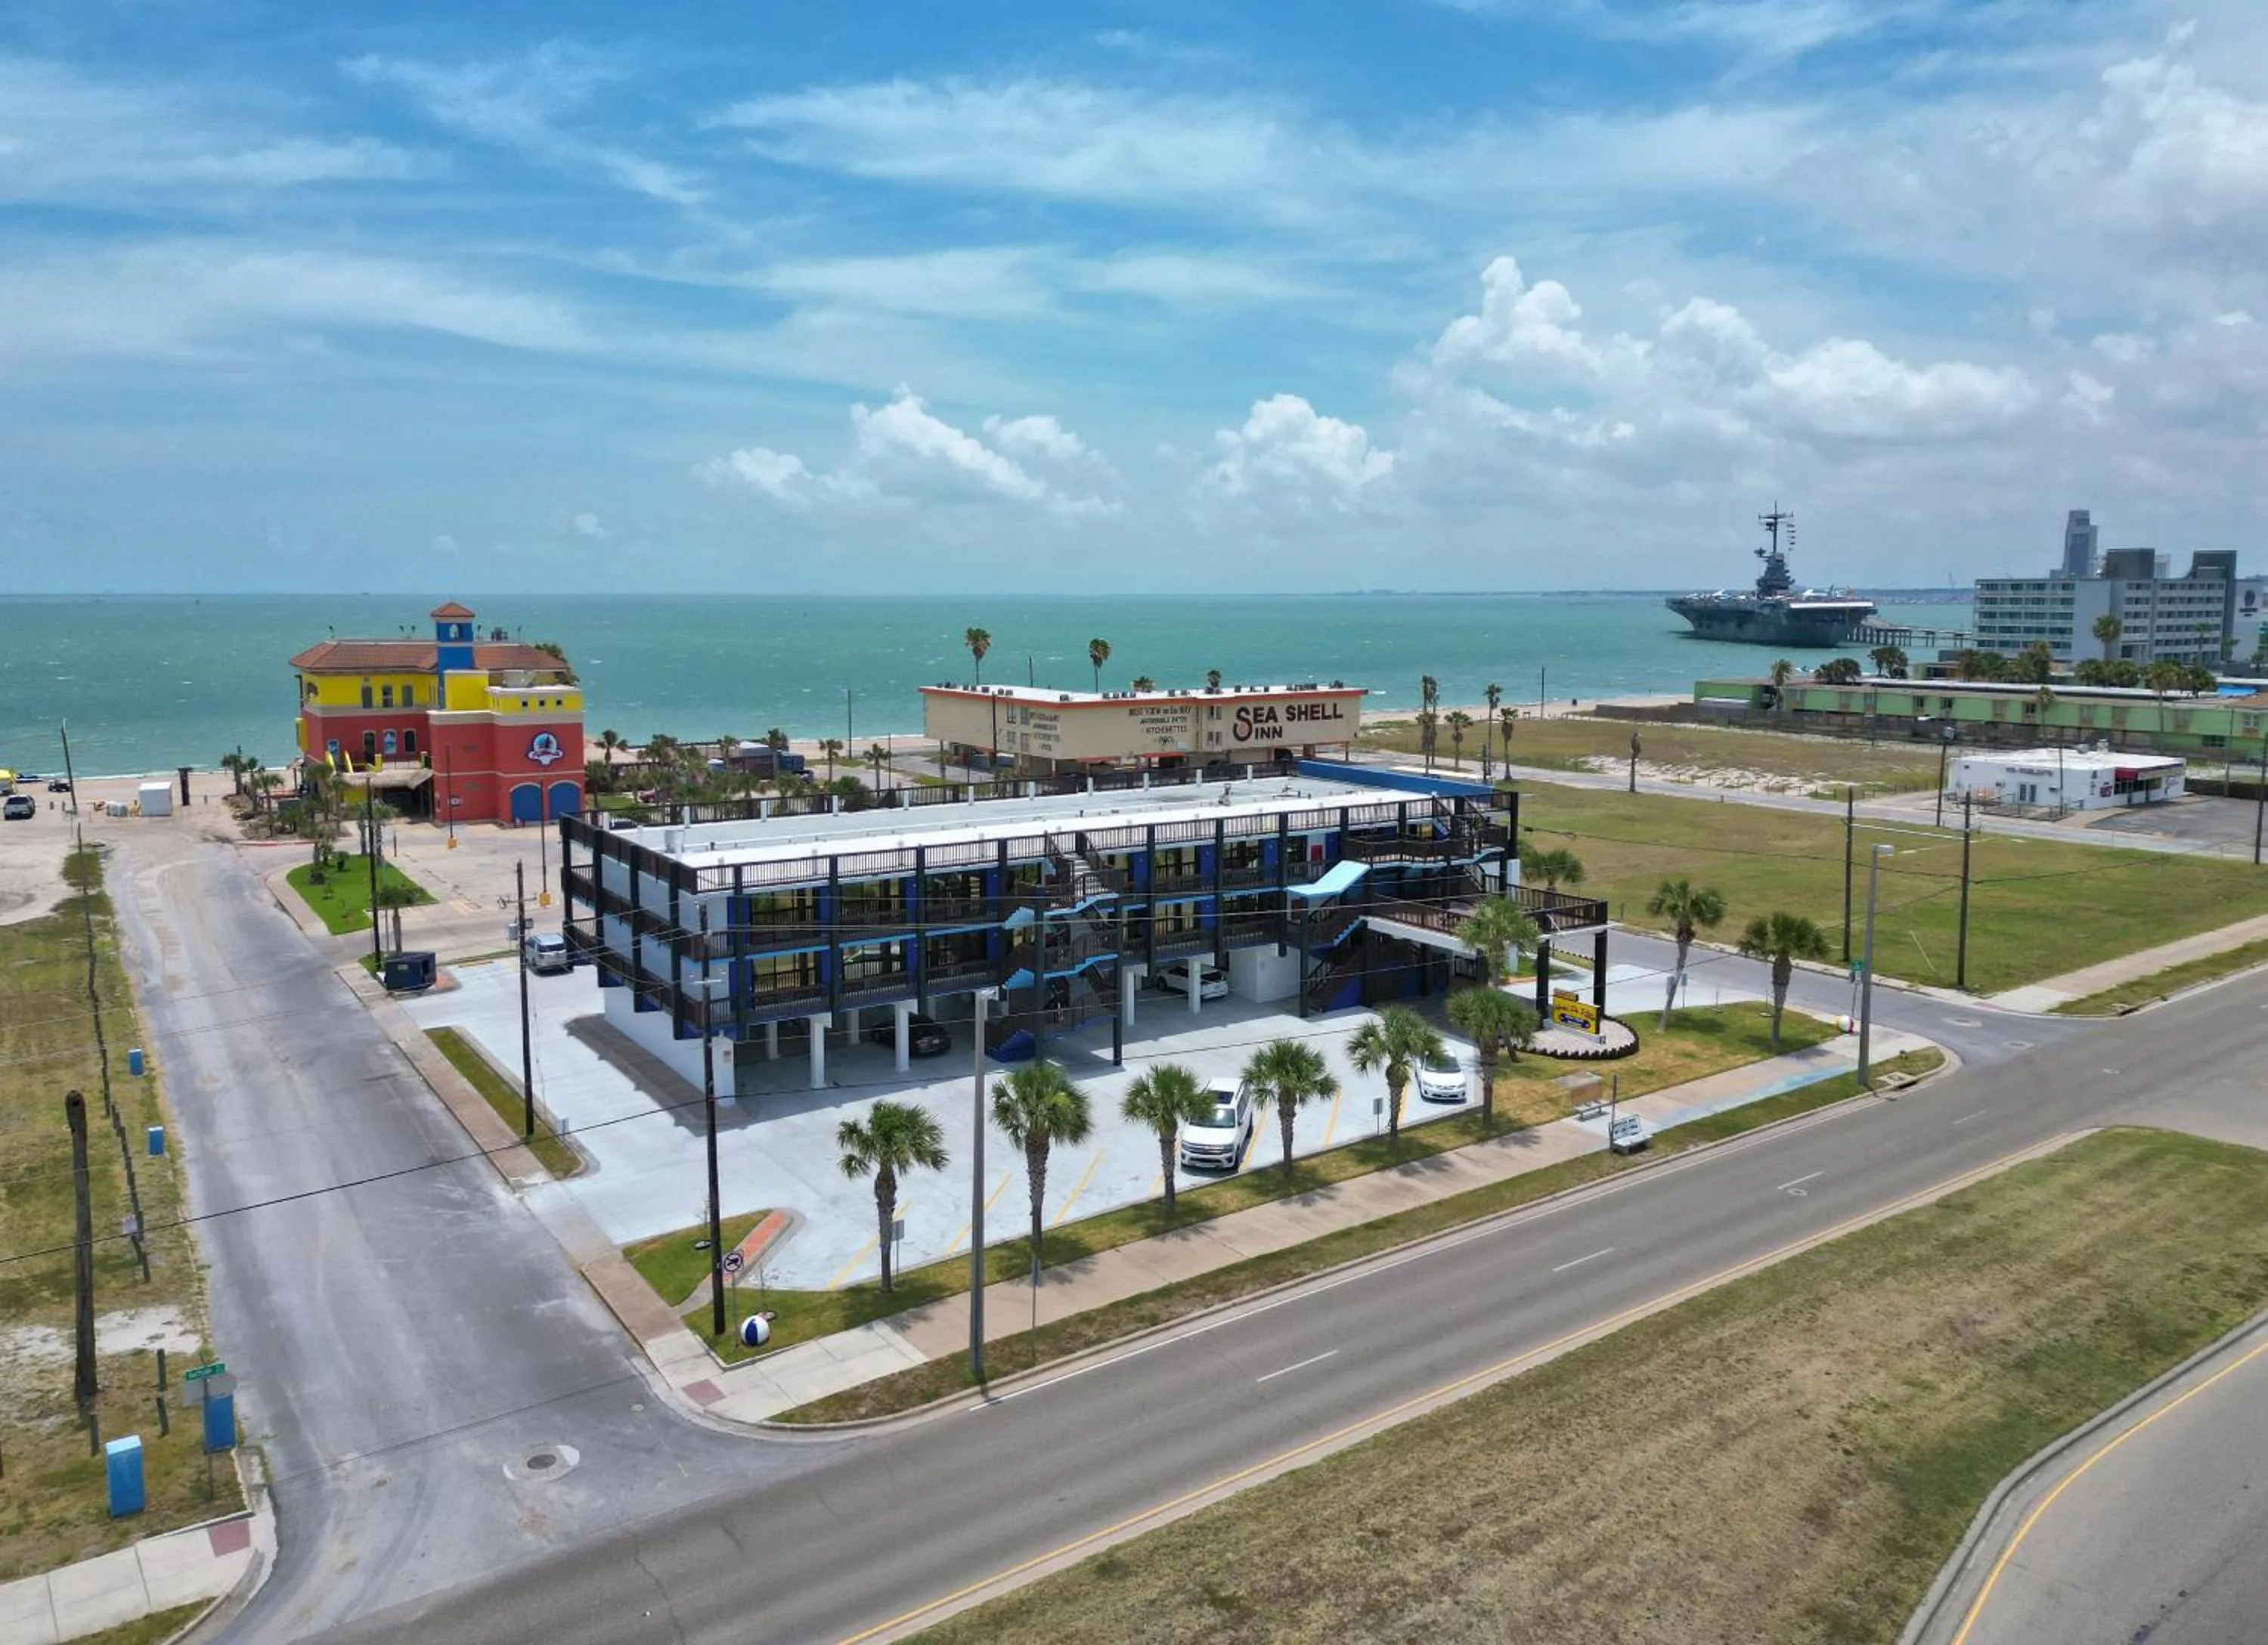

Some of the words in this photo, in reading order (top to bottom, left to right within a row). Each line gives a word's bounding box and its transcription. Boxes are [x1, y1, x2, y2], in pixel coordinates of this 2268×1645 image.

[1233, 706, 1278, 742] SEA
[1285, 702, 1343, 722] SHELL
[1254, 725, 1283, 740] INN
